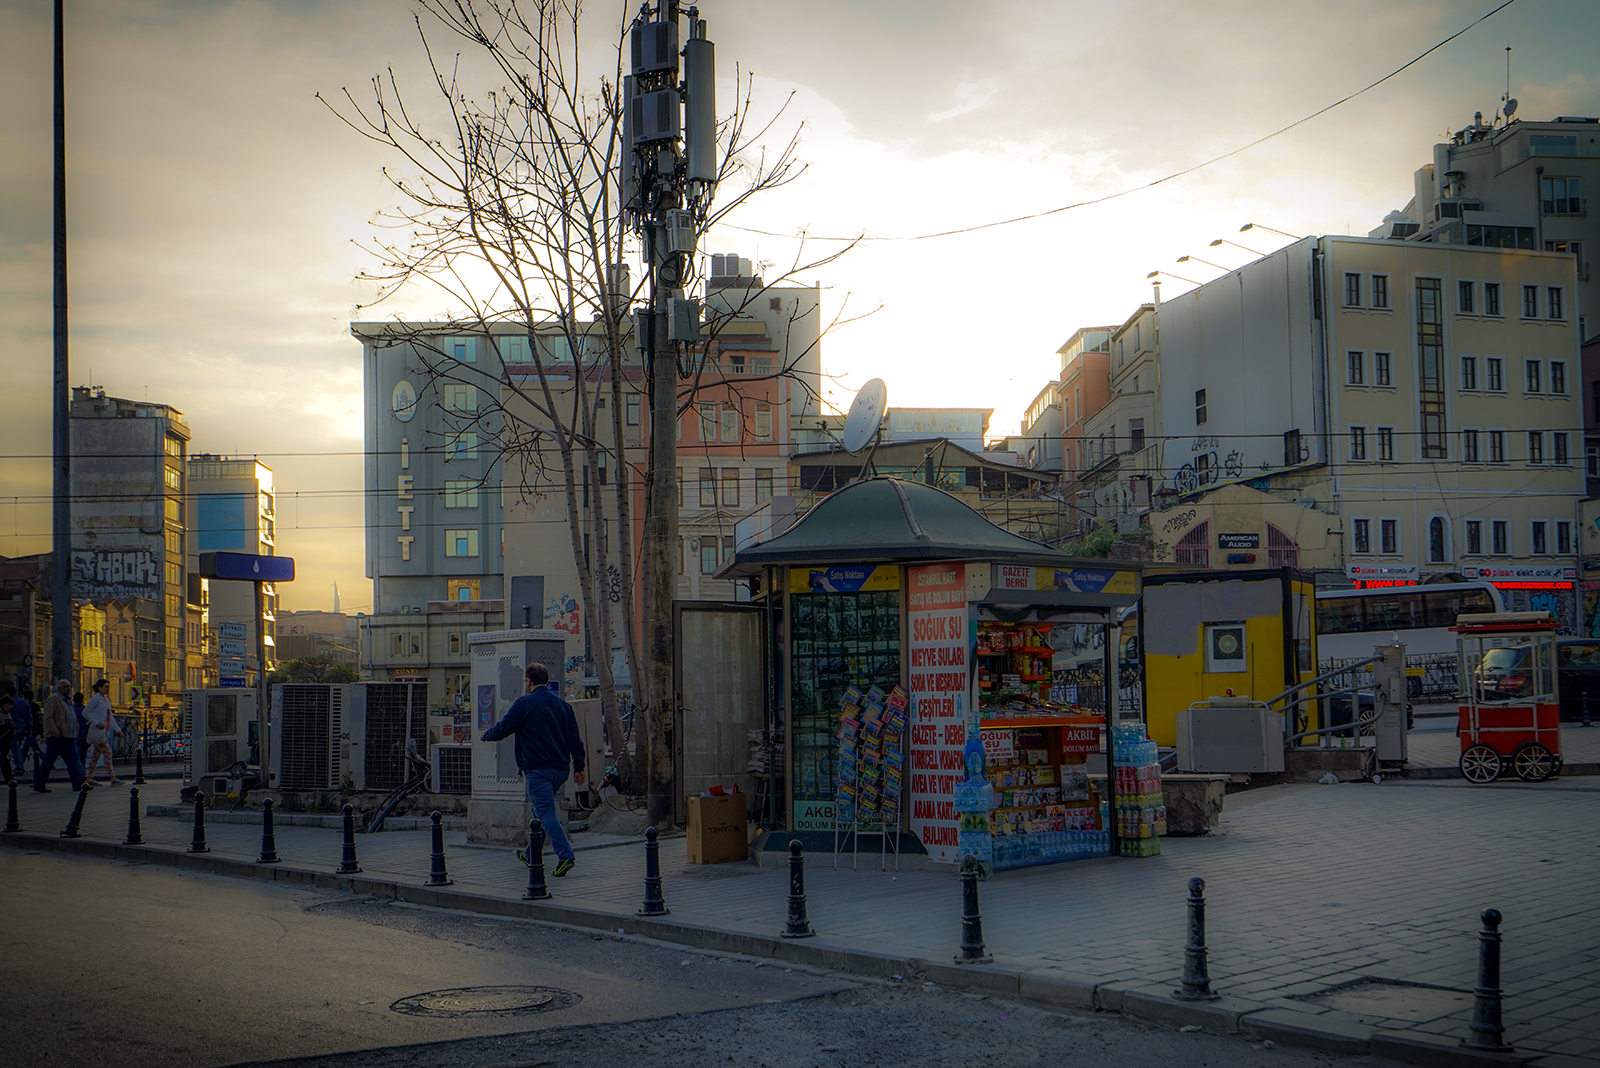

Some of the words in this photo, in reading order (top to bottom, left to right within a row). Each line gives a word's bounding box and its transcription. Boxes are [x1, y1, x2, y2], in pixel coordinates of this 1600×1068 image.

[830, 570, 844, 581] Satış
[844, 569, 864, 580] Noktası
[918, 572, 942, 586] İSTANBUL
[942, 571, 956, 585] KART
[1002, 567, 1030, 578] GAZETE
[1074, 572, 1087, 583] Satış
[1087, 573, 1106, 582] Noktası
[1492, 569, 1514, 578] pilsan
[1005, 577, 1028, 588] DERGİ
[910, 592, 924, 608] SATIŞ
[925, 592, 932, 605] VE
[933, 590, 950, 605] DOLUM
[914, 612, 946, 641] SOĞUK
[949, 616, 962, 640] SU
[912, 648, 936, 667] MEYVE
[938, 647, 964, 666] SULARI
[911, 674, 926, 692] SODA
[927, 674, 934, 692] VE
[936, 672, 966, 696] MEŞRUBAT
[919, 694, 954, 722] ÇEŞİTLERİ
[912, 725, 936, 745] GAZETE
[945, 720, 965, 745] DERGİ
[980, 732, 1011, 741] OĞUK
[1067, 728, 1096, 741] AKBİL
[911, 750, 939, 770] TURKCELL
[939, 750, 964, 770] VODAFON
[912, 775, 927, 793] AVEA
[928, 775, 937, 793] VE
[938, 775, 954, 794] YURT
[804, 804, 836, 818] AKBİ
[914, 801, 936, 819] ARAMA
[1066, 809, 1094, 817] ALEM
[798, 821, 828, 829] DOLUM
[923, 826, 958, 846] BULUNUR
